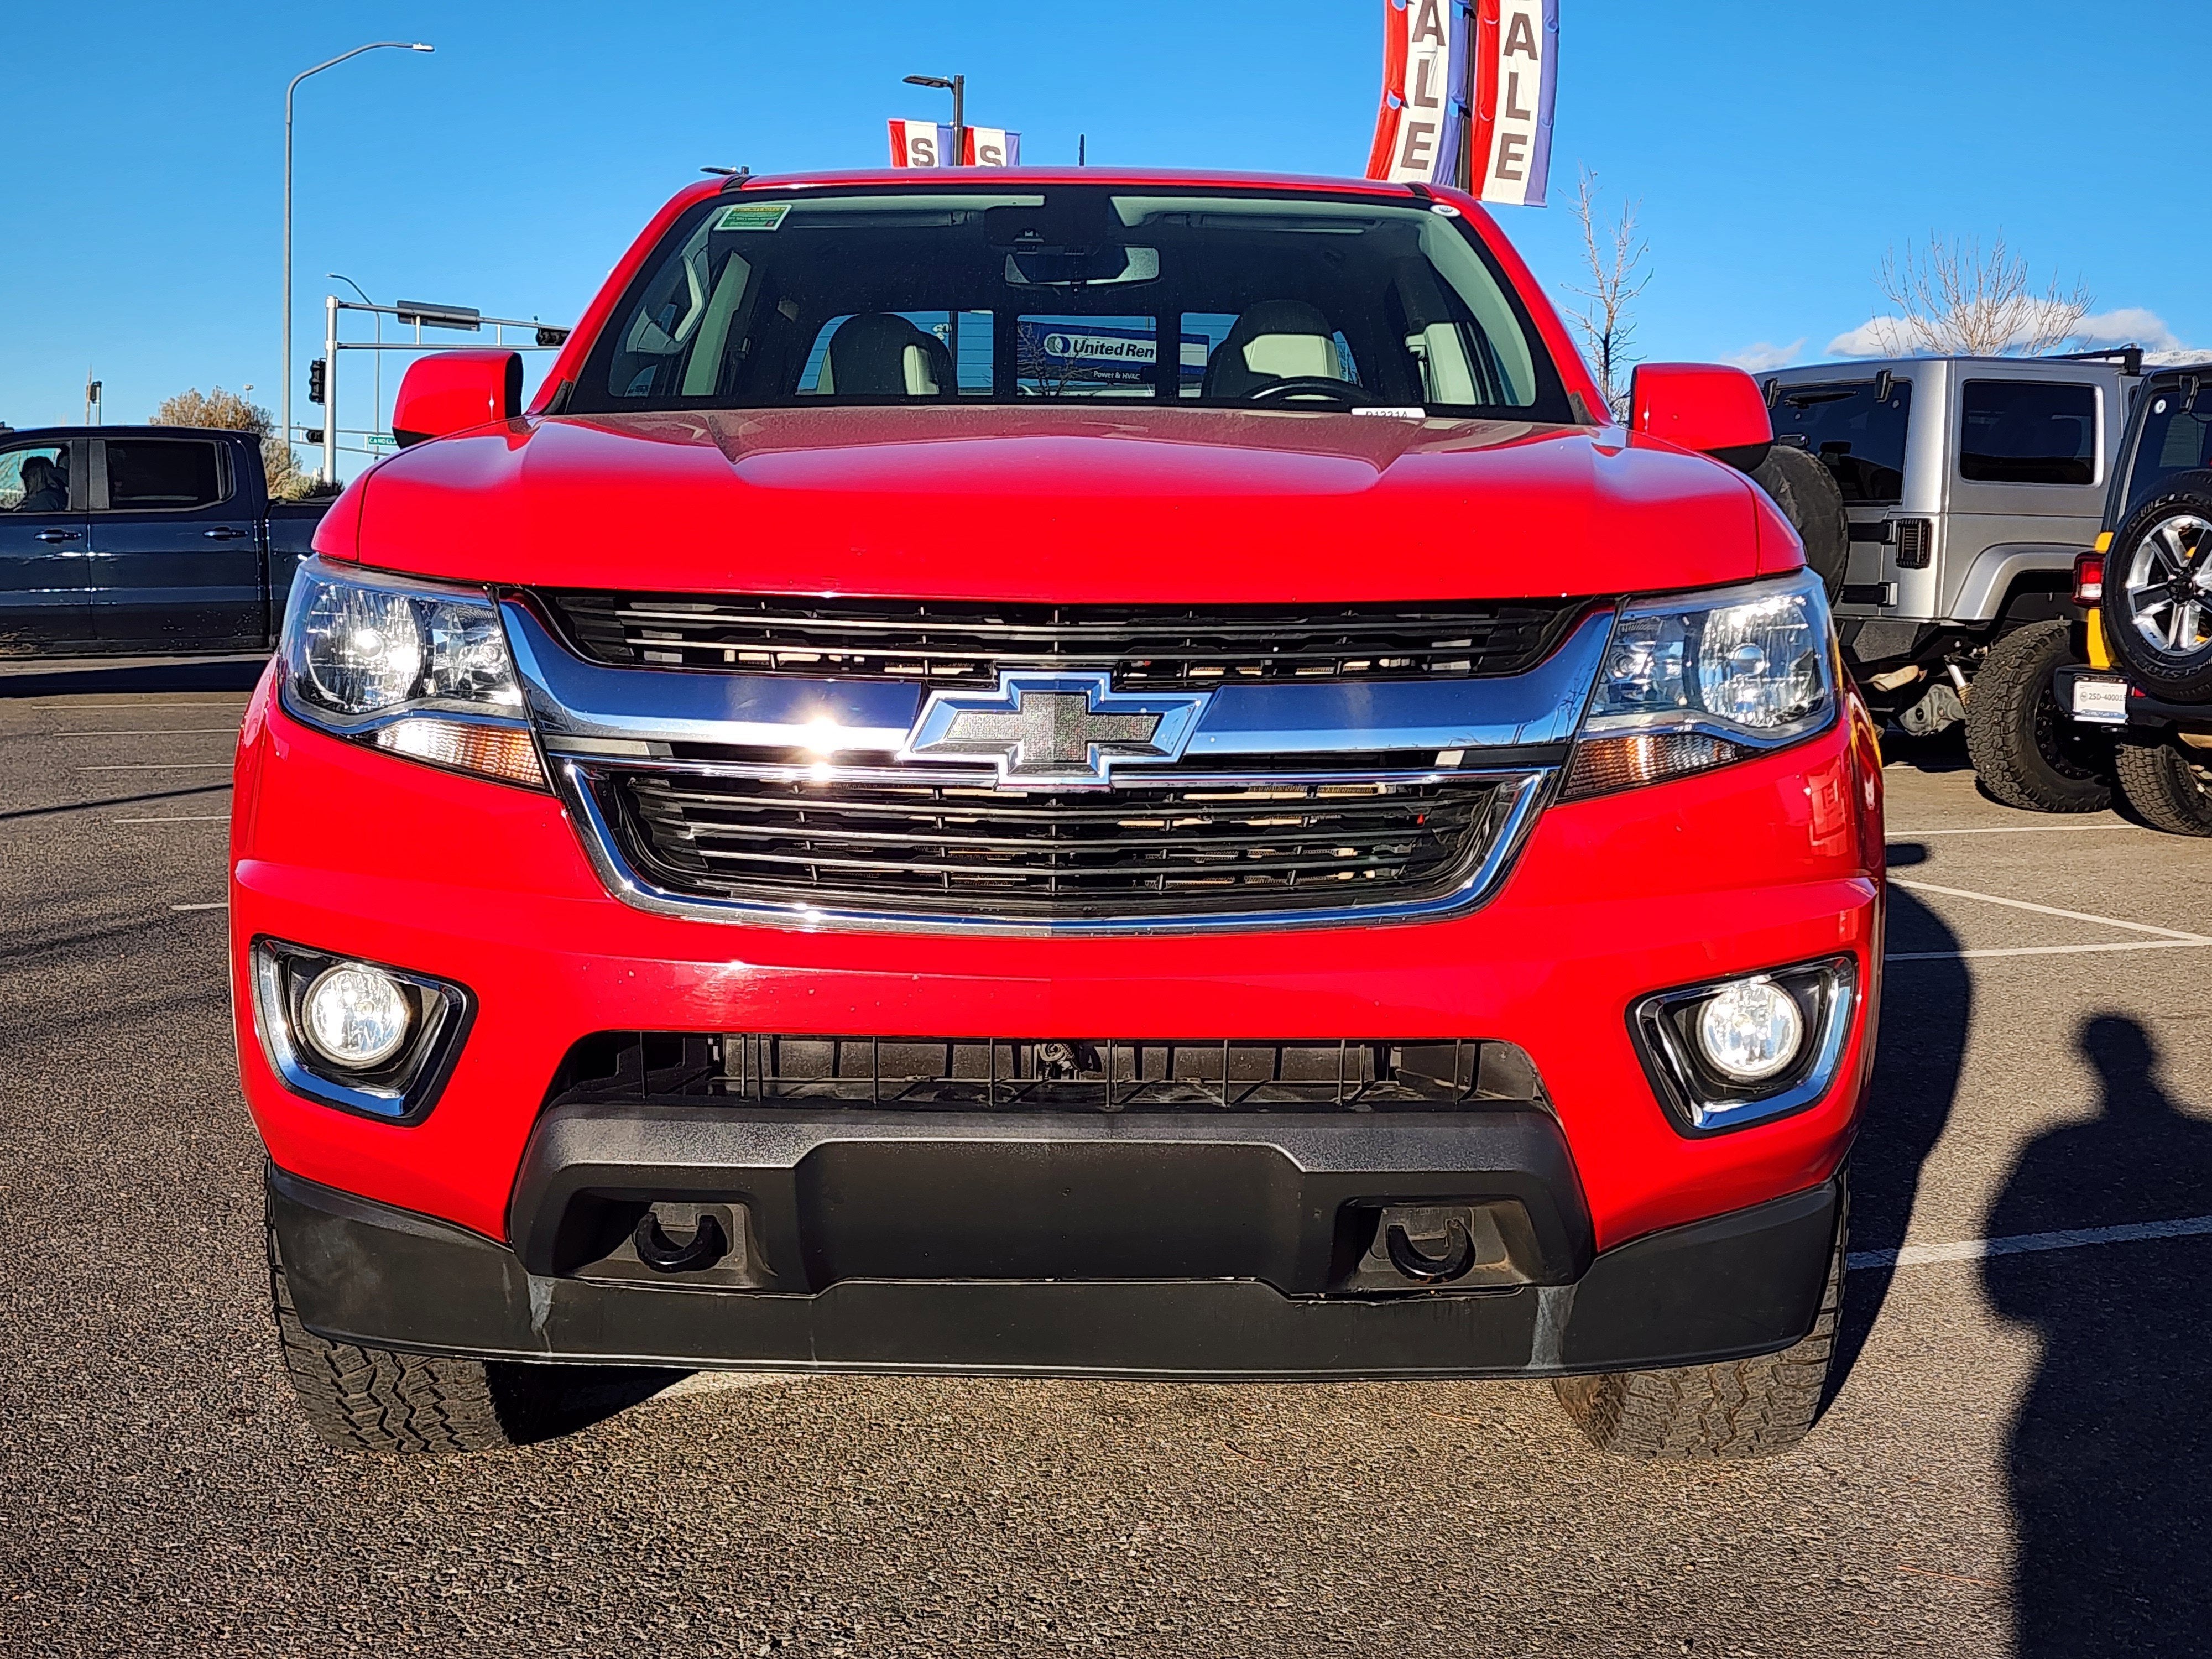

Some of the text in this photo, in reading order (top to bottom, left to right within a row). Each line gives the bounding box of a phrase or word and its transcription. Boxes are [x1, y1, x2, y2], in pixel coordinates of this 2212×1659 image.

[1495, 12, 1538, 181] ALE
[911, 137, 935, 166] S
[1073, 339, 1155, 358] United Ren
[1093, 370, 1114, 379] Power
